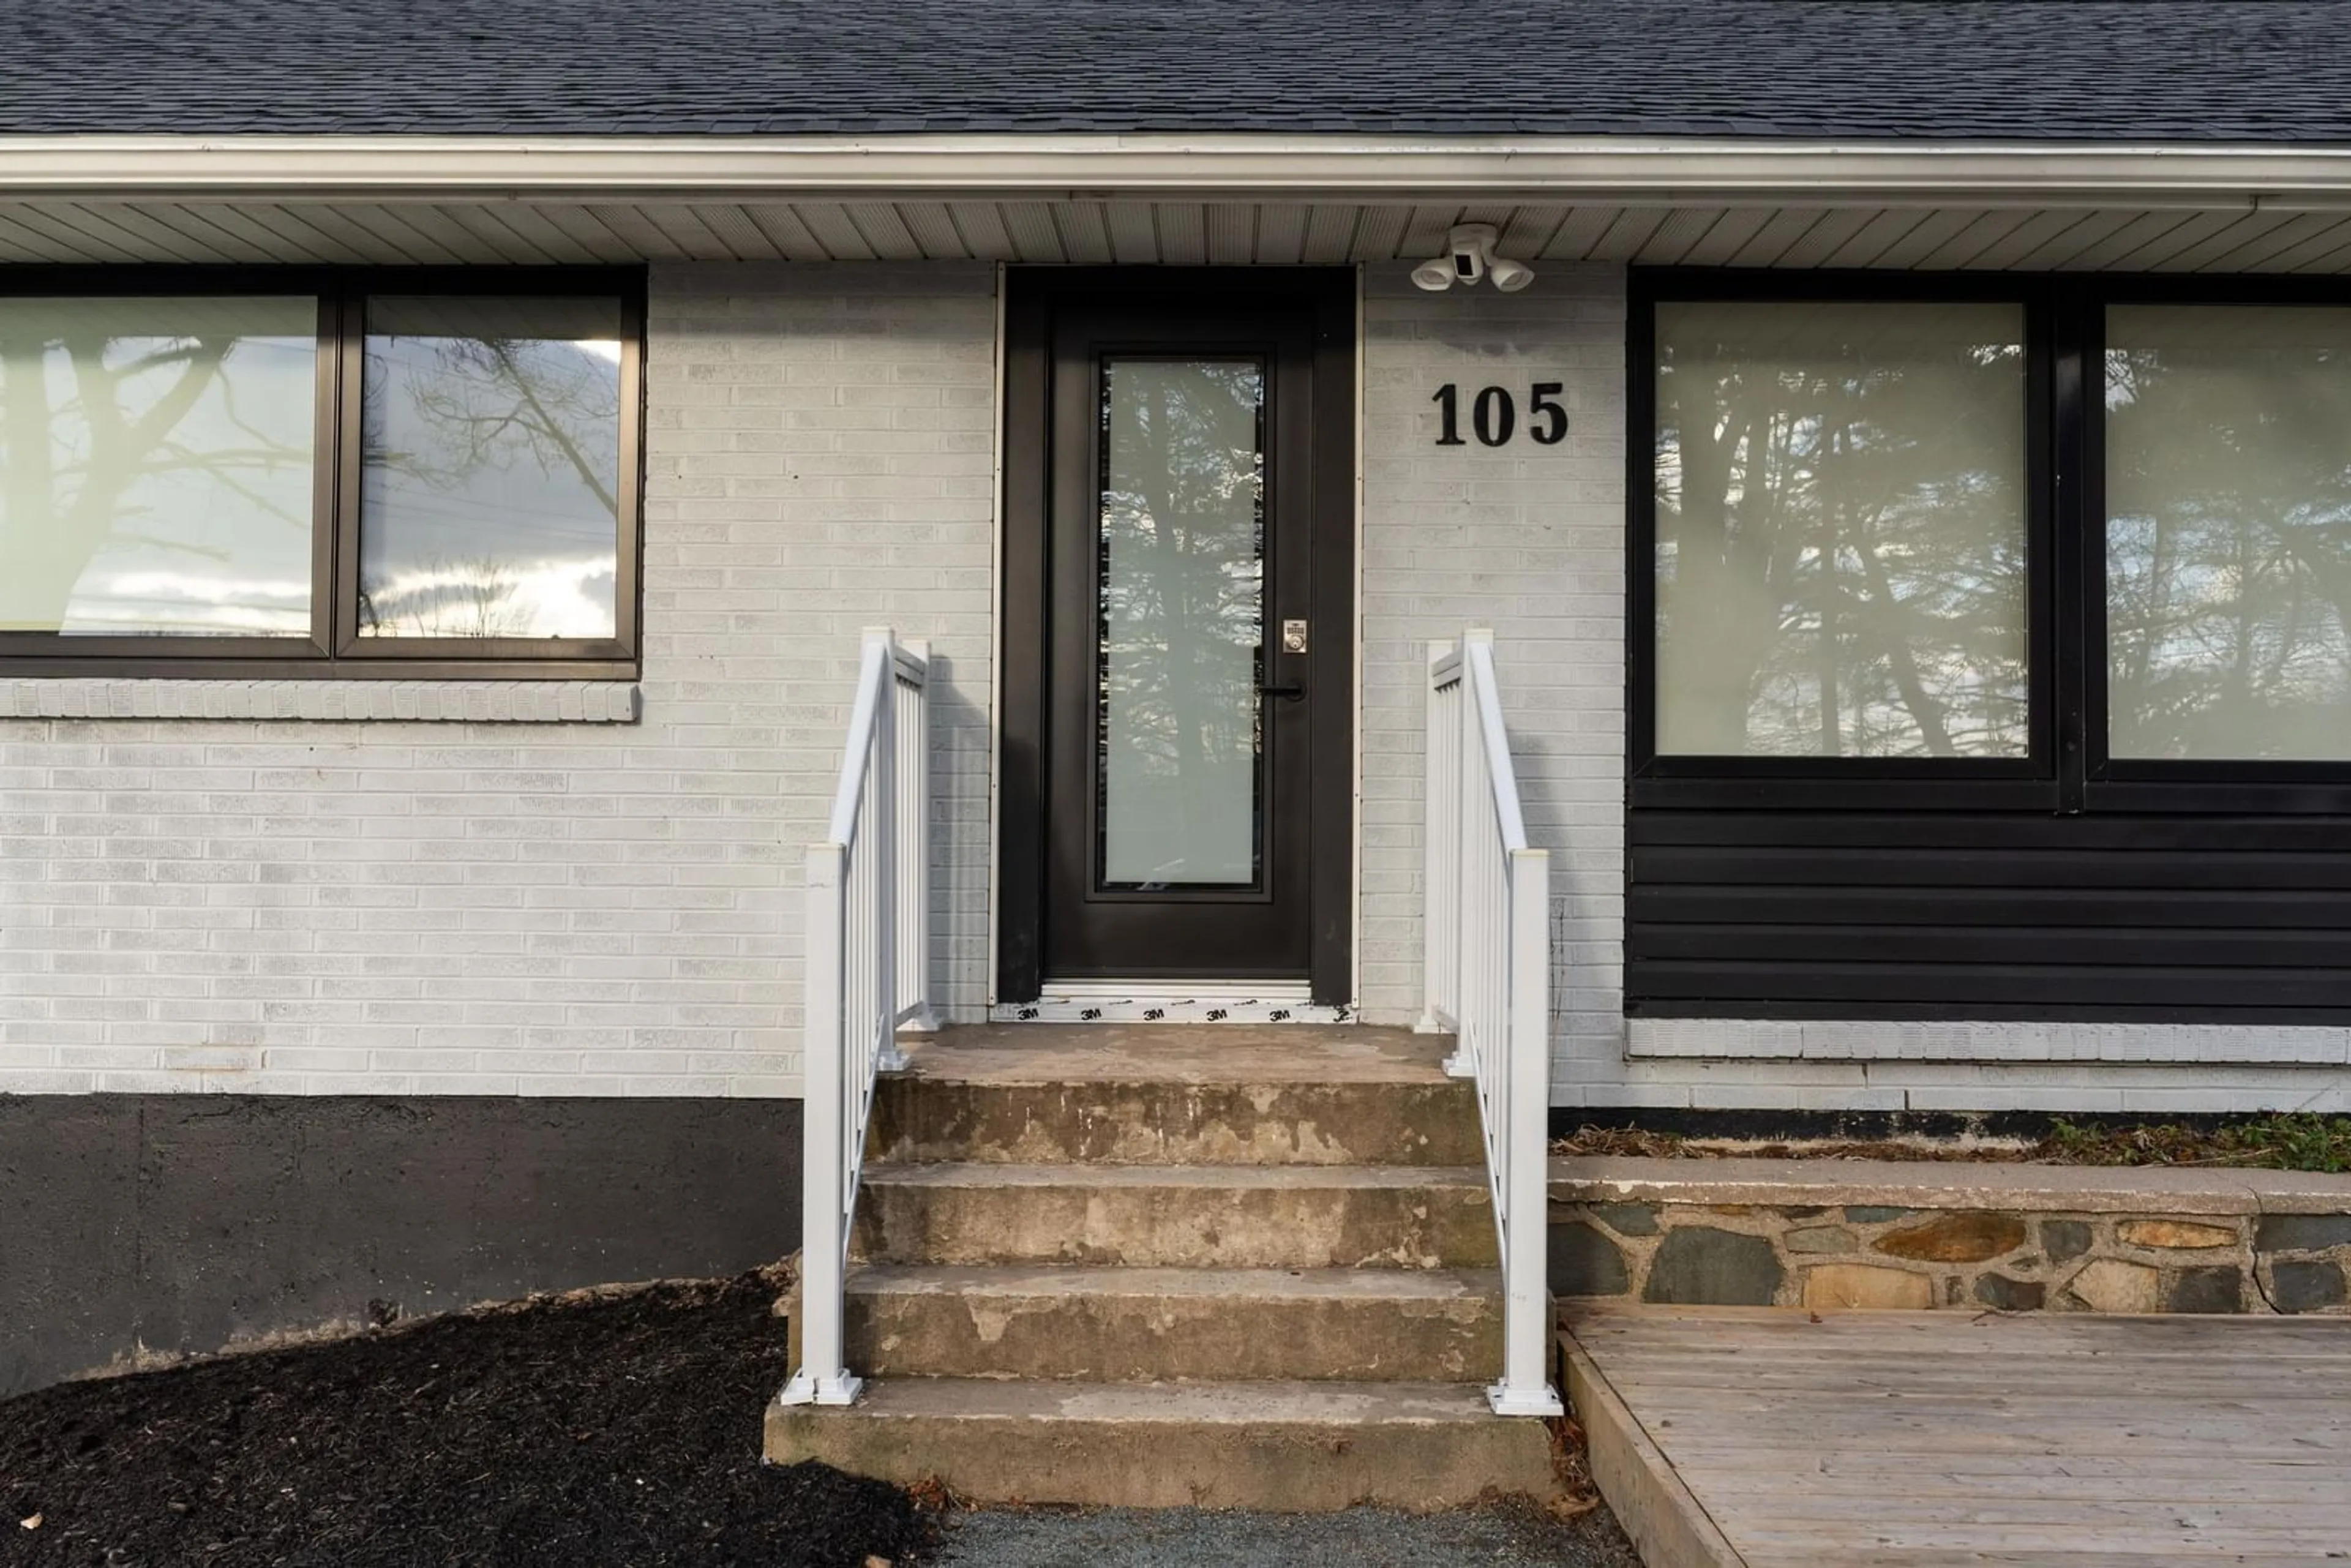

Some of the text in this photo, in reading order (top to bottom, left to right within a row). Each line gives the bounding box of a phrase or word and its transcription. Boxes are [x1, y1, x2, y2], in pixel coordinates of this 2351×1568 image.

[1431, 382, 1569, 448] 105
[1018, 1008, 1291, 1022] 3M 3M 3M 3M 3M
